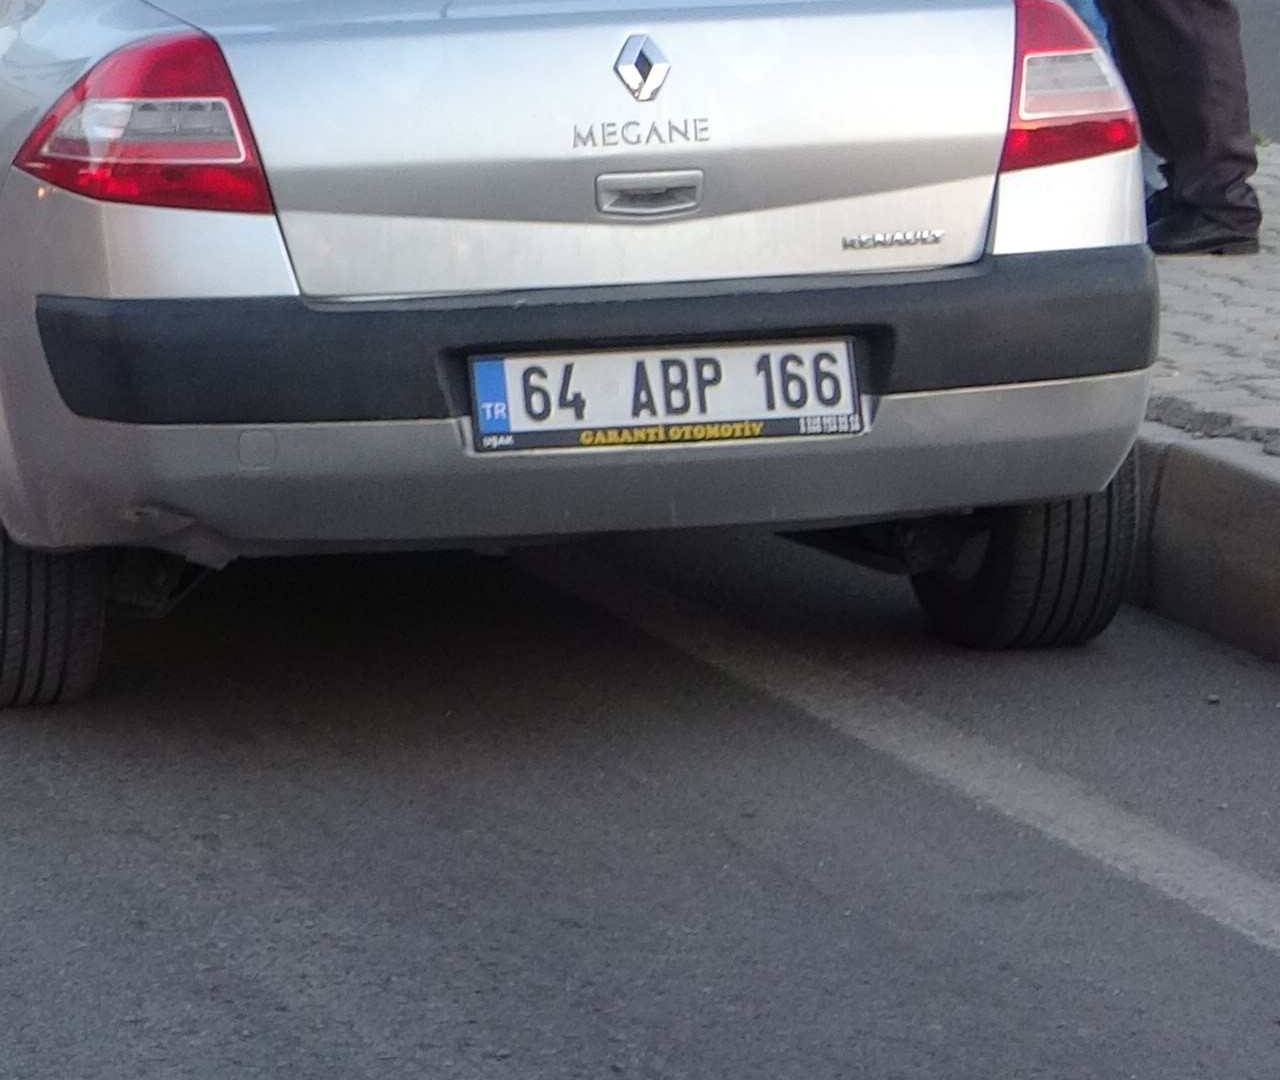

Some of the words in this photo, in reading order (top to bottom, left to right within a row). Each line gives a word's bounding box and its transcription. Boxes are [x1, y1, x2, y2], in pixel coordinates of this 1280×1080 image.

[573, 118, 710, 149] MEGANE
[842, 229, 945, 251] RENAULT
[522, 361, 587, 423] 64
[632, 357, 723, 419] ABP
[756, 352, 842, 412] 166
[481, 401, 508, 421] TR
[579, 424, 665, 446] GARANTİ
[668, 419, 765, 441] OTOMOTİV
